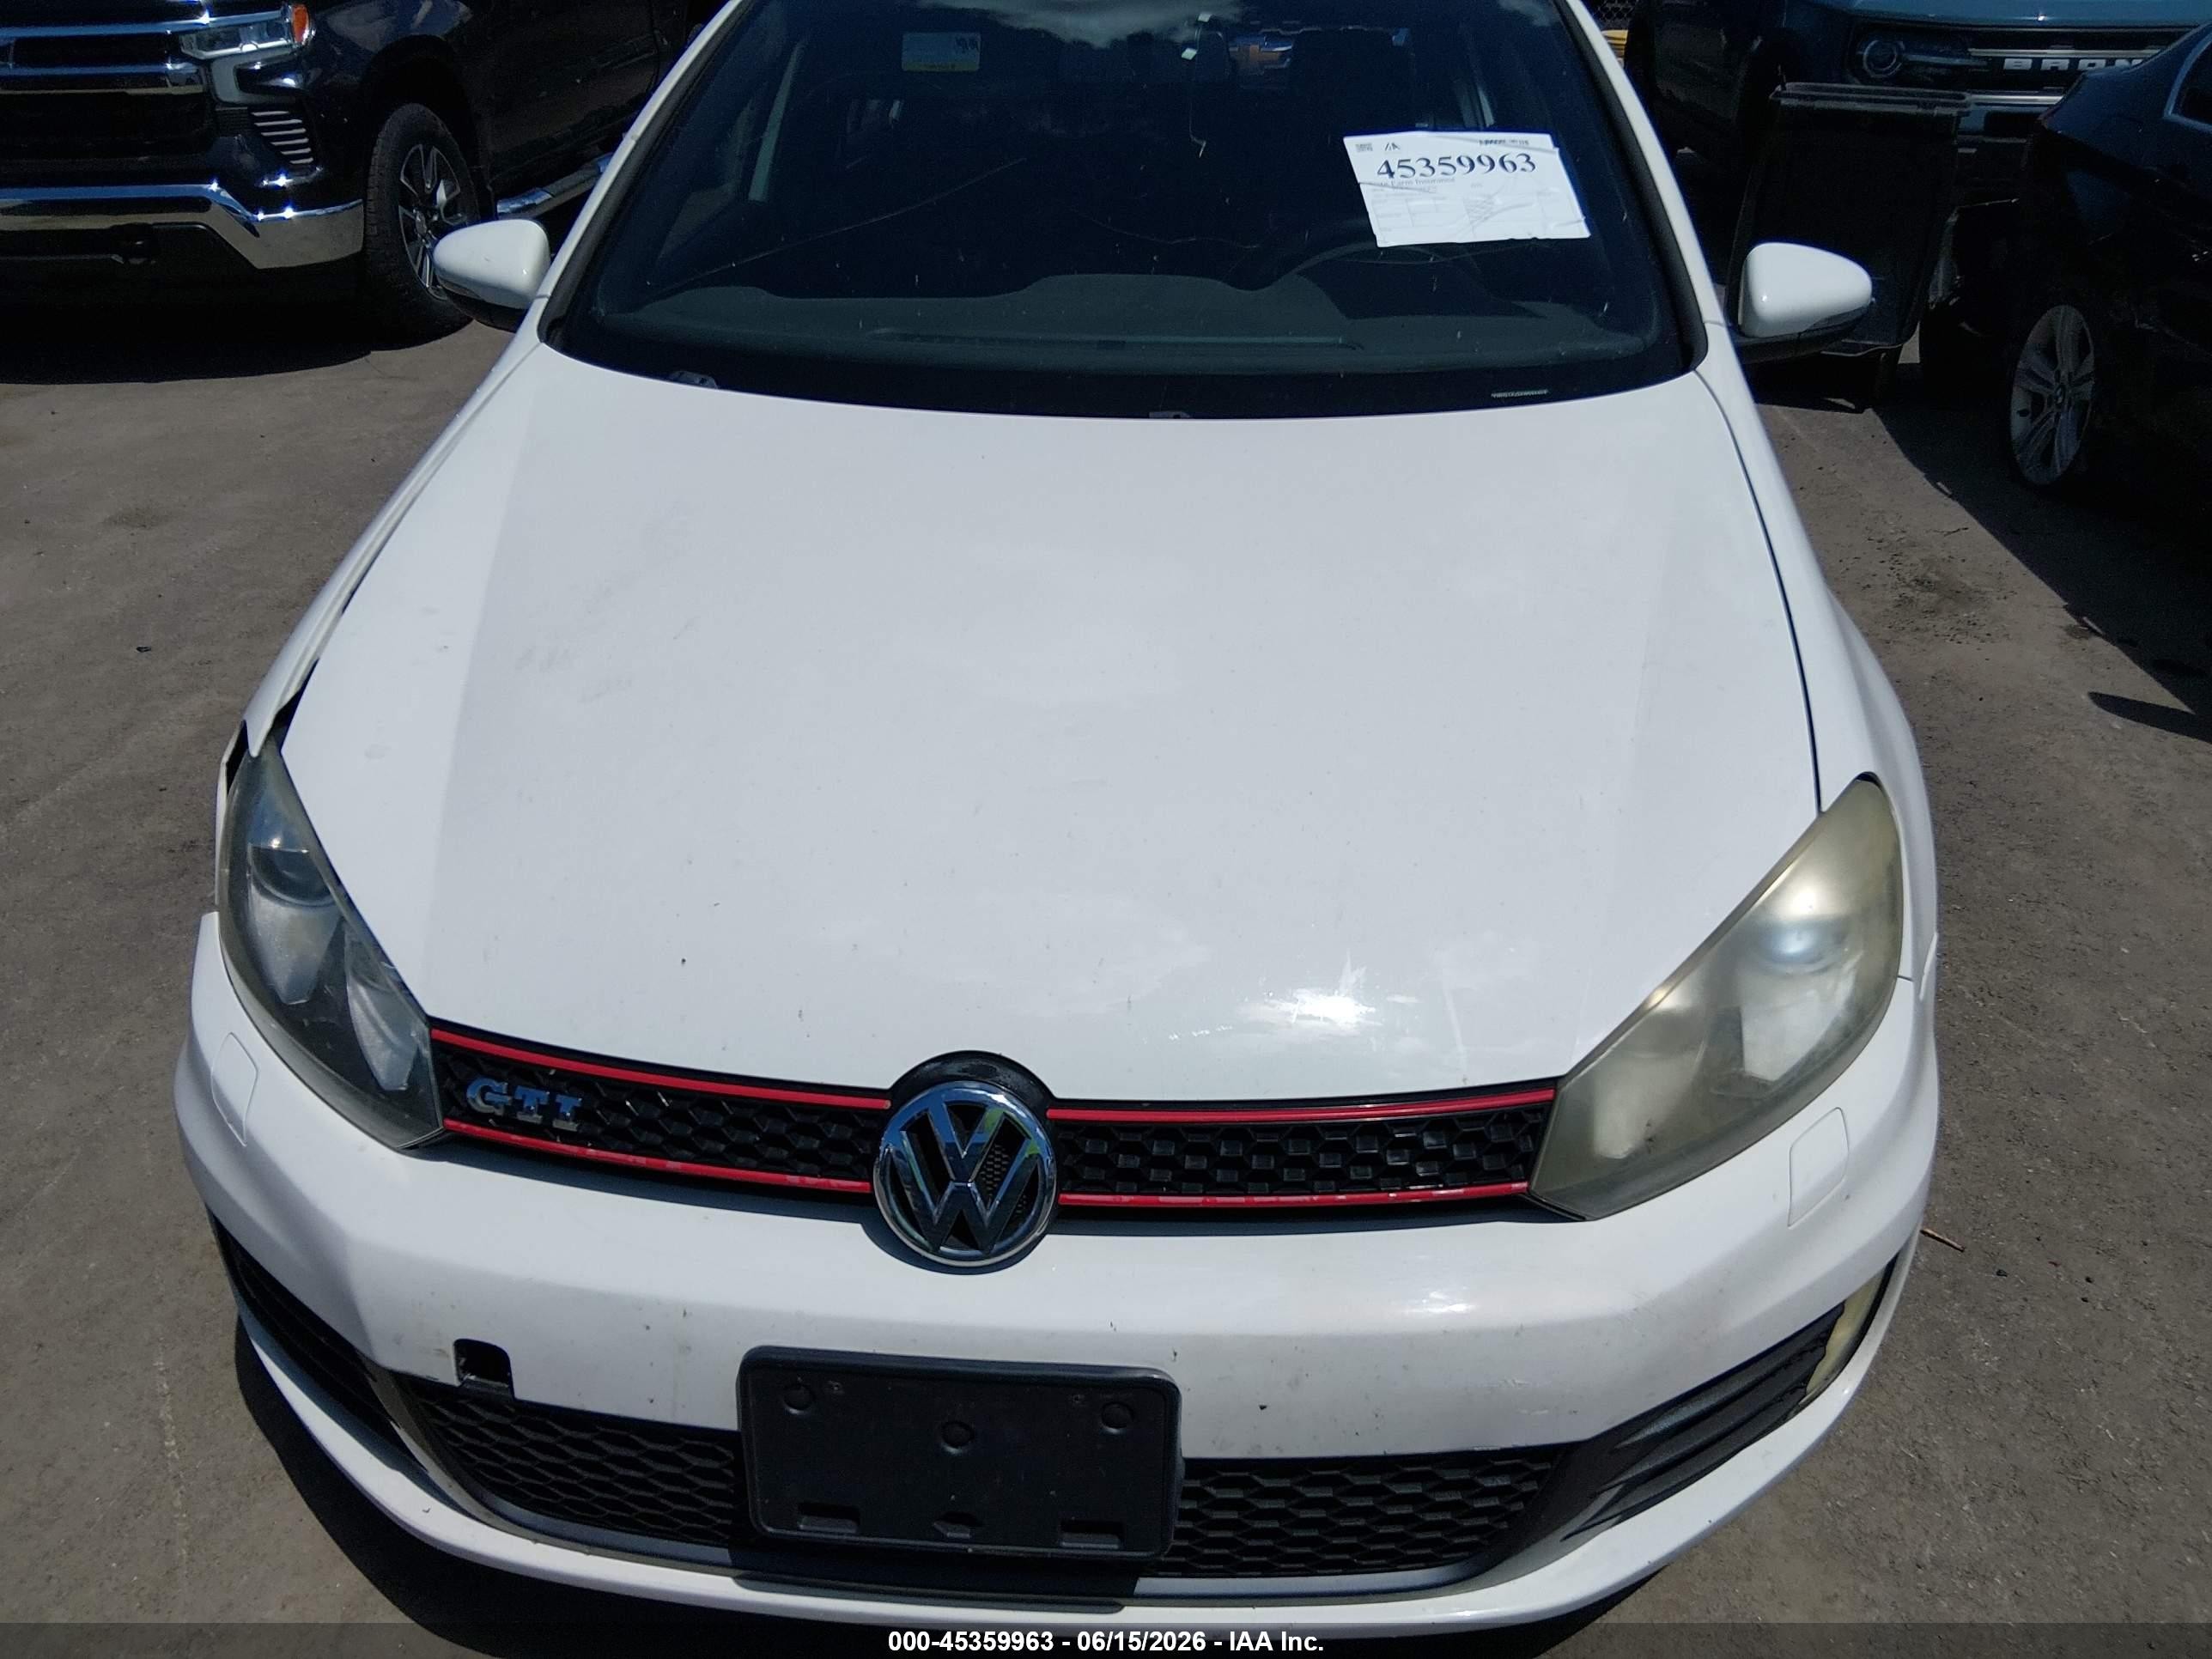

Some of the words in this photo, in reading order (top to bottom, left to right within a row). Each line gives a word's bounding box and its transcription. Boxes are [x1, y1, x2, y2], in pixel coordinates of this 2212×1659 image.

[1376, 153, 1536, 179] 45359963
[466, 1078, 582, 1132] GTI
[879, 1087, 1052, 1261] VW
